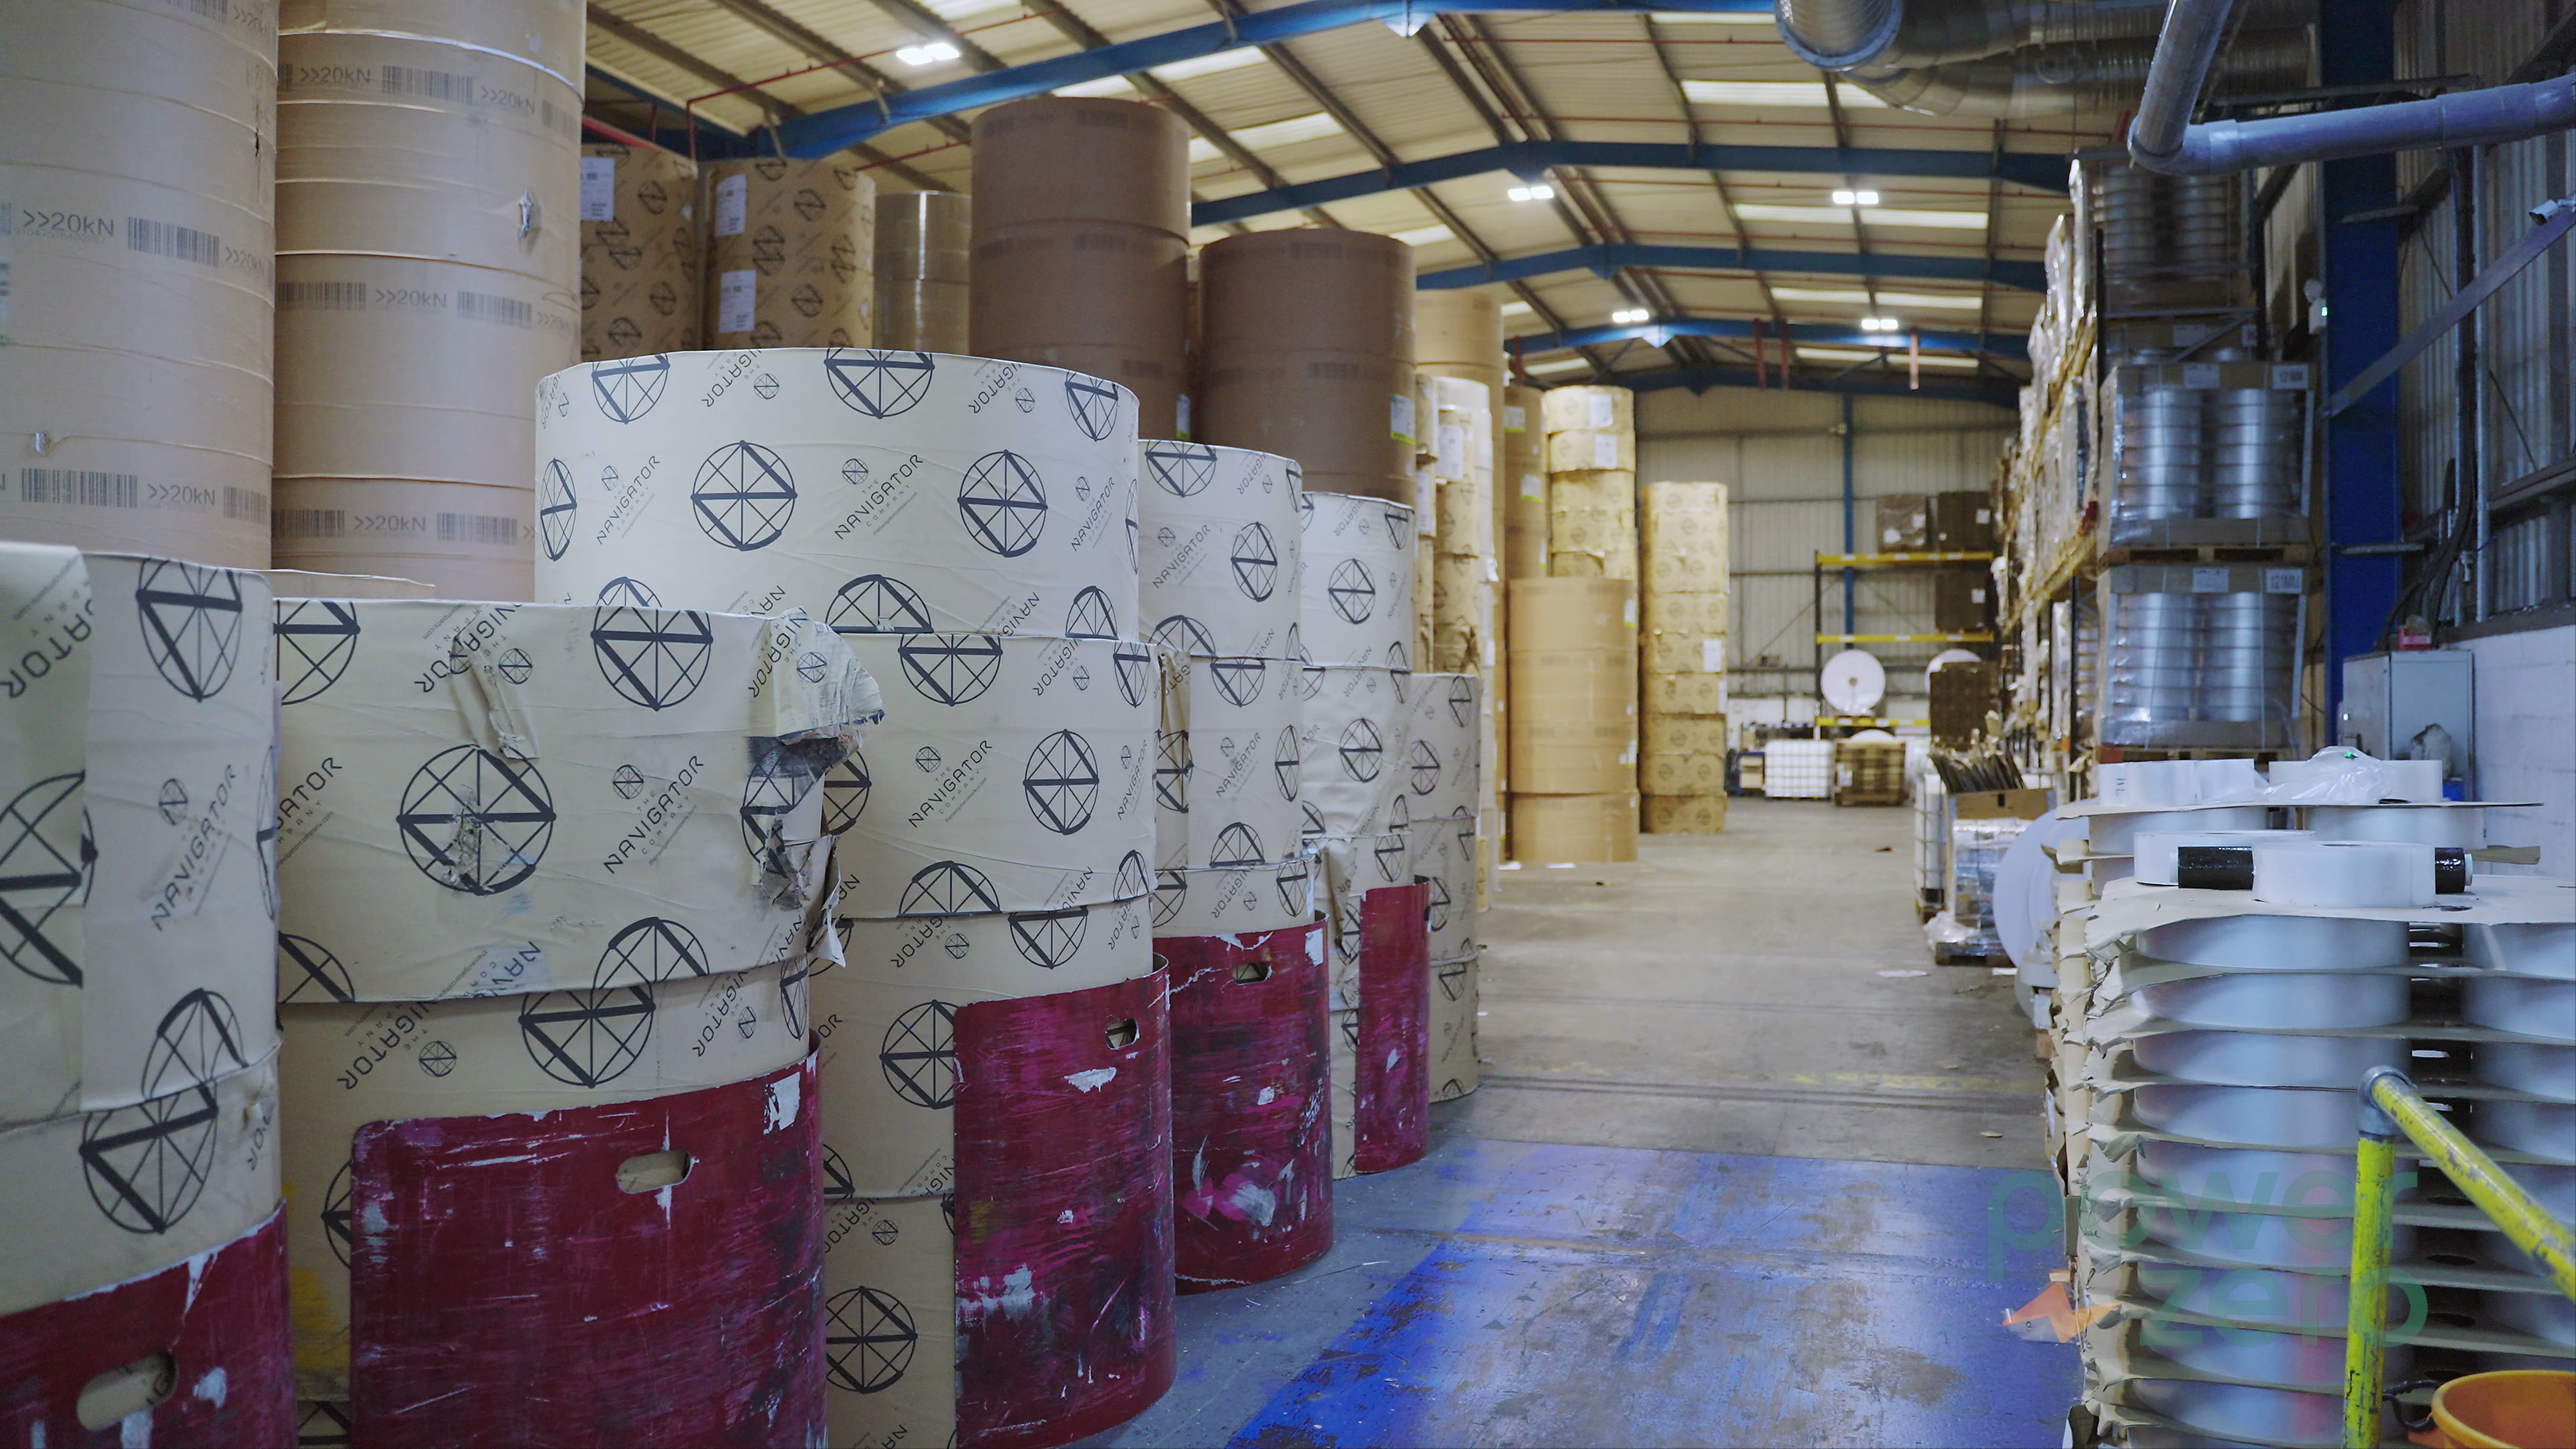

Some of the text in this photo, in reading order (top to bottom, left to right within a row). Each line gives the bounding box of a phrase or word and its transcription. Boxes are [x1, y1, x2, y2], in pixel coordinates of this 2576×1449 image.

[301, 66, 370, 85] >>20kN
[23, 209, 115, 237] >>20kN
[376, 288, 447, 309] >>20kN
[701, 349, 762, 408] IGATOR
[968, 362, 1022, 414] IGATOR
[147, 476, 215, 505] >>20kN
[596, 455, 661, 545] NAVIGATOR
[834, 454, 924, 540] NAVIGATOR
[865, 484, 910, 527] COMPANY
[1071, 476, 1115, 552] NAVIGATOR
[354, 515, 426, 532] >>20kN
[1152, 524, 1211, 589] NAVIGATOR
[997, 591, 1040, 637] NAVIG
[483, 634, 507, 657] THE
[908, 740, 993, 828] NAVIGATOR
[1117, 739, 1148, 821] NAVIGATOR
[1216, 731, 1262, 799] NAVIGATOR
[603, 755, 704, 875] NAVIGATOR
[637, 790, 656, 812] THE
[938, 769, 980, 815] COMPANY
[151, 763, 236, 932] NAVIGATOR
[641, 795, 690, 855] COMPANY
[890, 916, 948, 968] GATOR
[404, 1027, 429, 1051] THE
